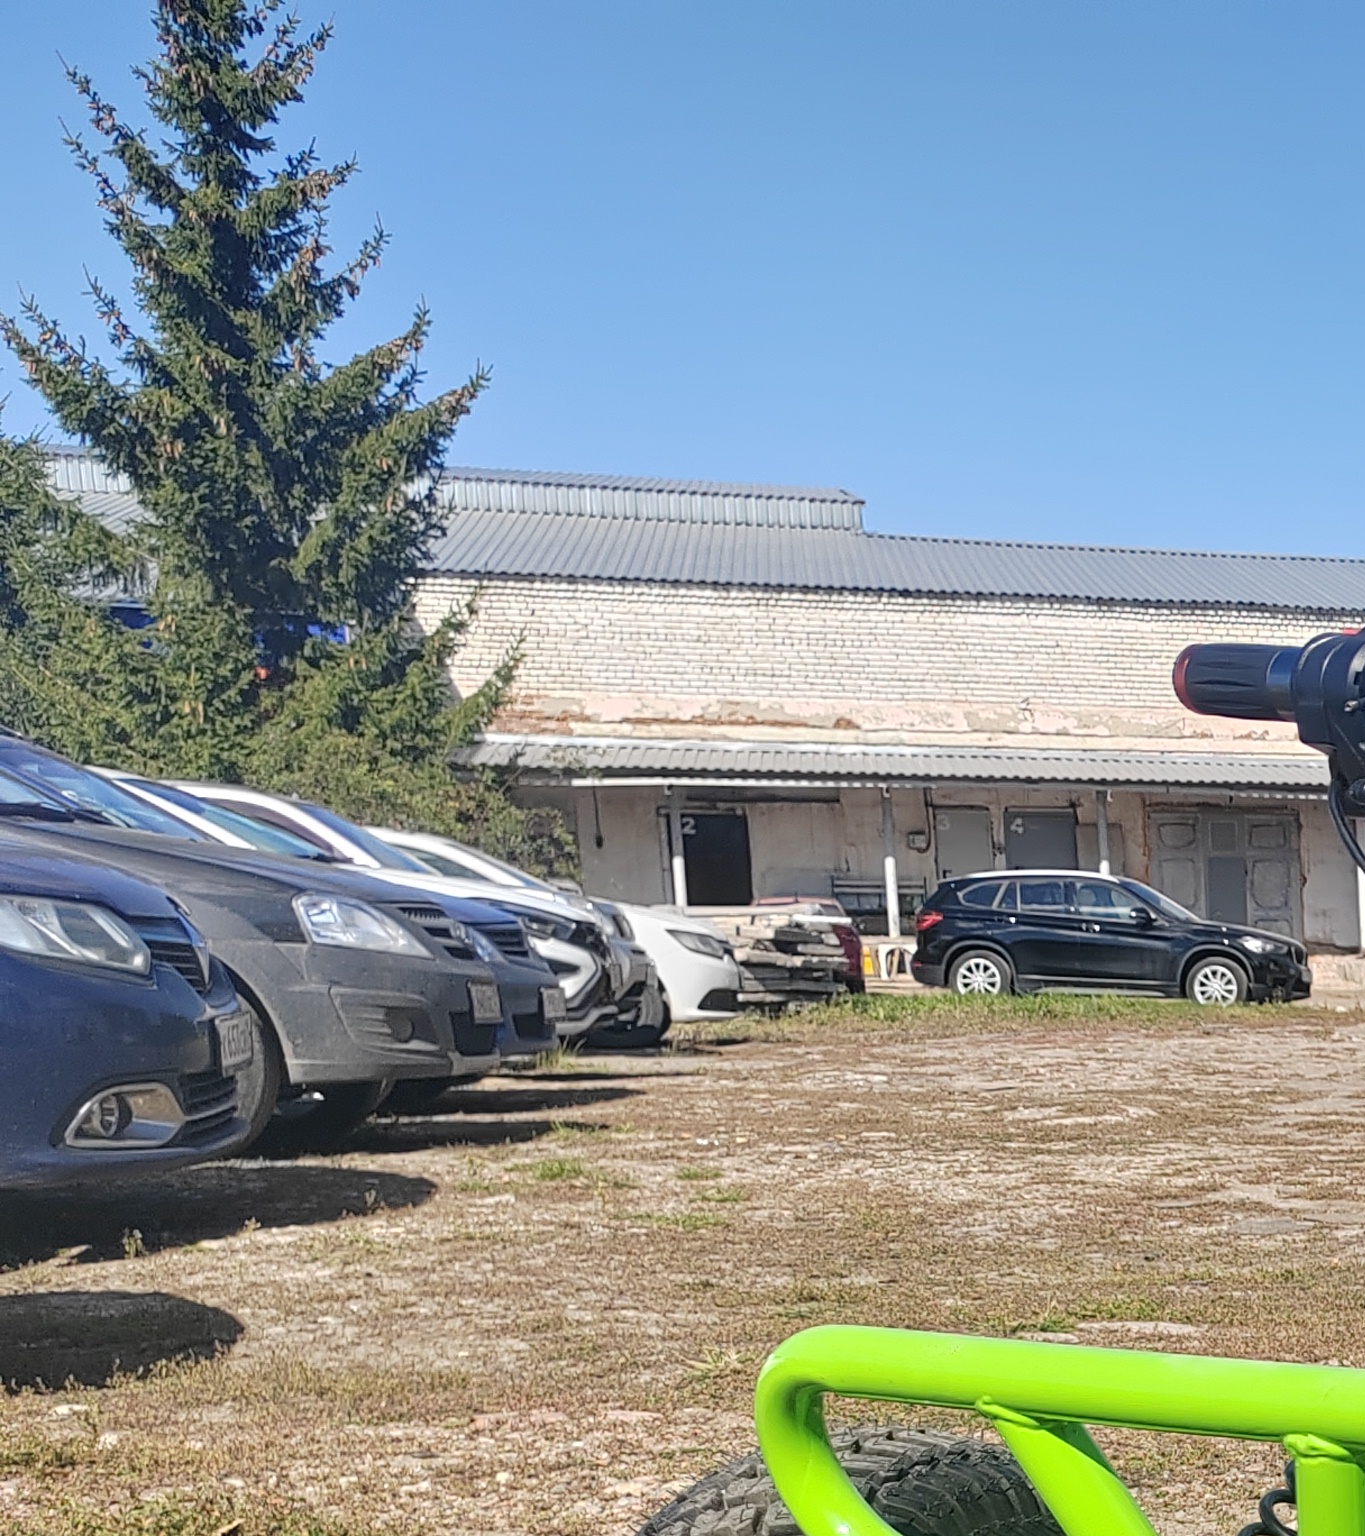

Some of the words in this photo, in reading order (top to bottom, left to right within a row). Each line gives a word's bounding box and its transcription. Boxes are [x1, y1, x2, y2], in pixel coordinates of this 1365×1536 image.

[681, 817, 697, 835] 2
[937, 815, 950, 831] 3
[1010, 817, 1024, 834] 4
